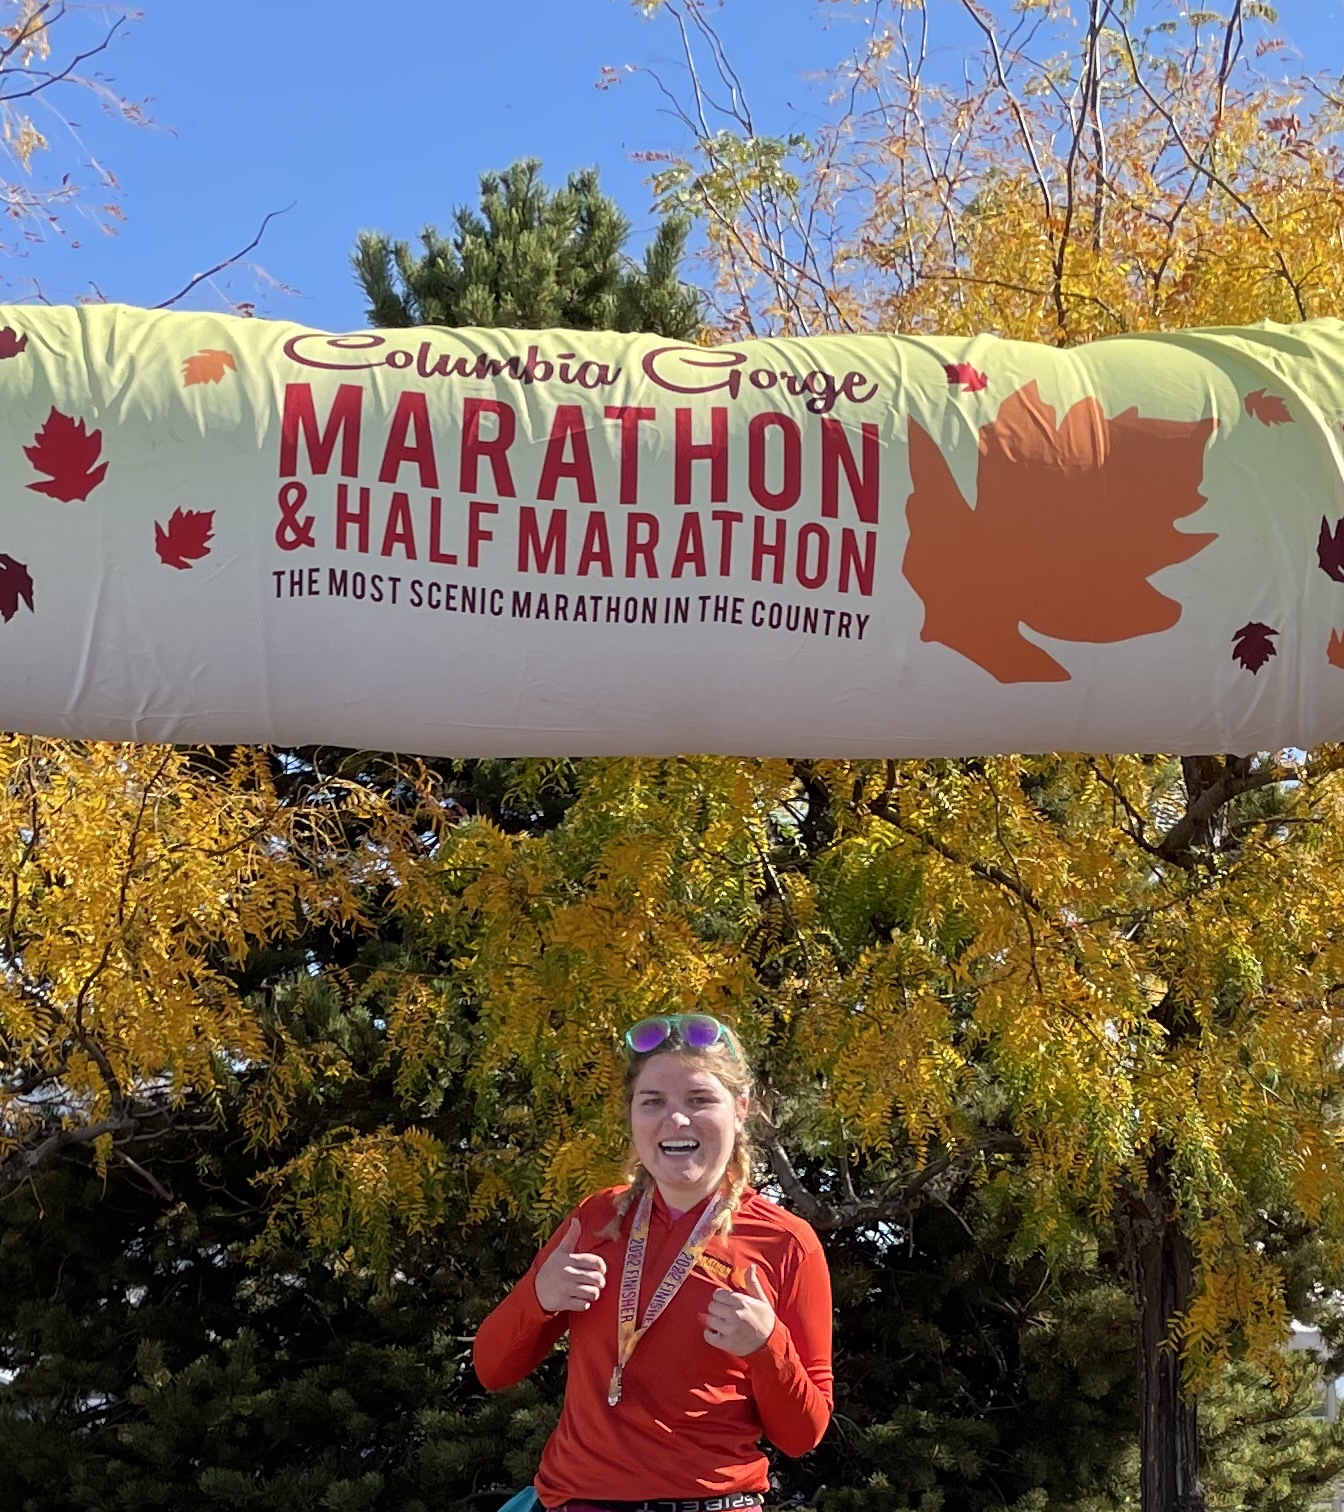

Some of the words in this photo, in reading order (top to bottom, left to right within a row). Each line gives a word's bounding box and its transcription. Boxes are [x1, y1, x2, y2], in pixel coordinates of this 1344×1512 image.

[283, 333, 622, 389] Columbia
[641, 345, 879, 415] Gorge
[279, 382, 880, 525] MARATHON
[275, 481, 316, 551] &
[336, 483, 500, 569] HALF
[517, 505, 877, 597] MARATHON
[272, 567, 321, 599] THE
[328, 567, 402, 606] MOST
[410, 579, 505, 617] SCENIC
[511, 590, 658, 625] MARATHON
[663, 596, 690, 625] IN
[698, 594, 745, 626] THE
[751, 600, 871, 641] COUNTRY
[628, 1237, 645, 1267] 2022
[667, 1251, 695, 1281] 2022
[619, 1269, 640, 1324] FINISHER
